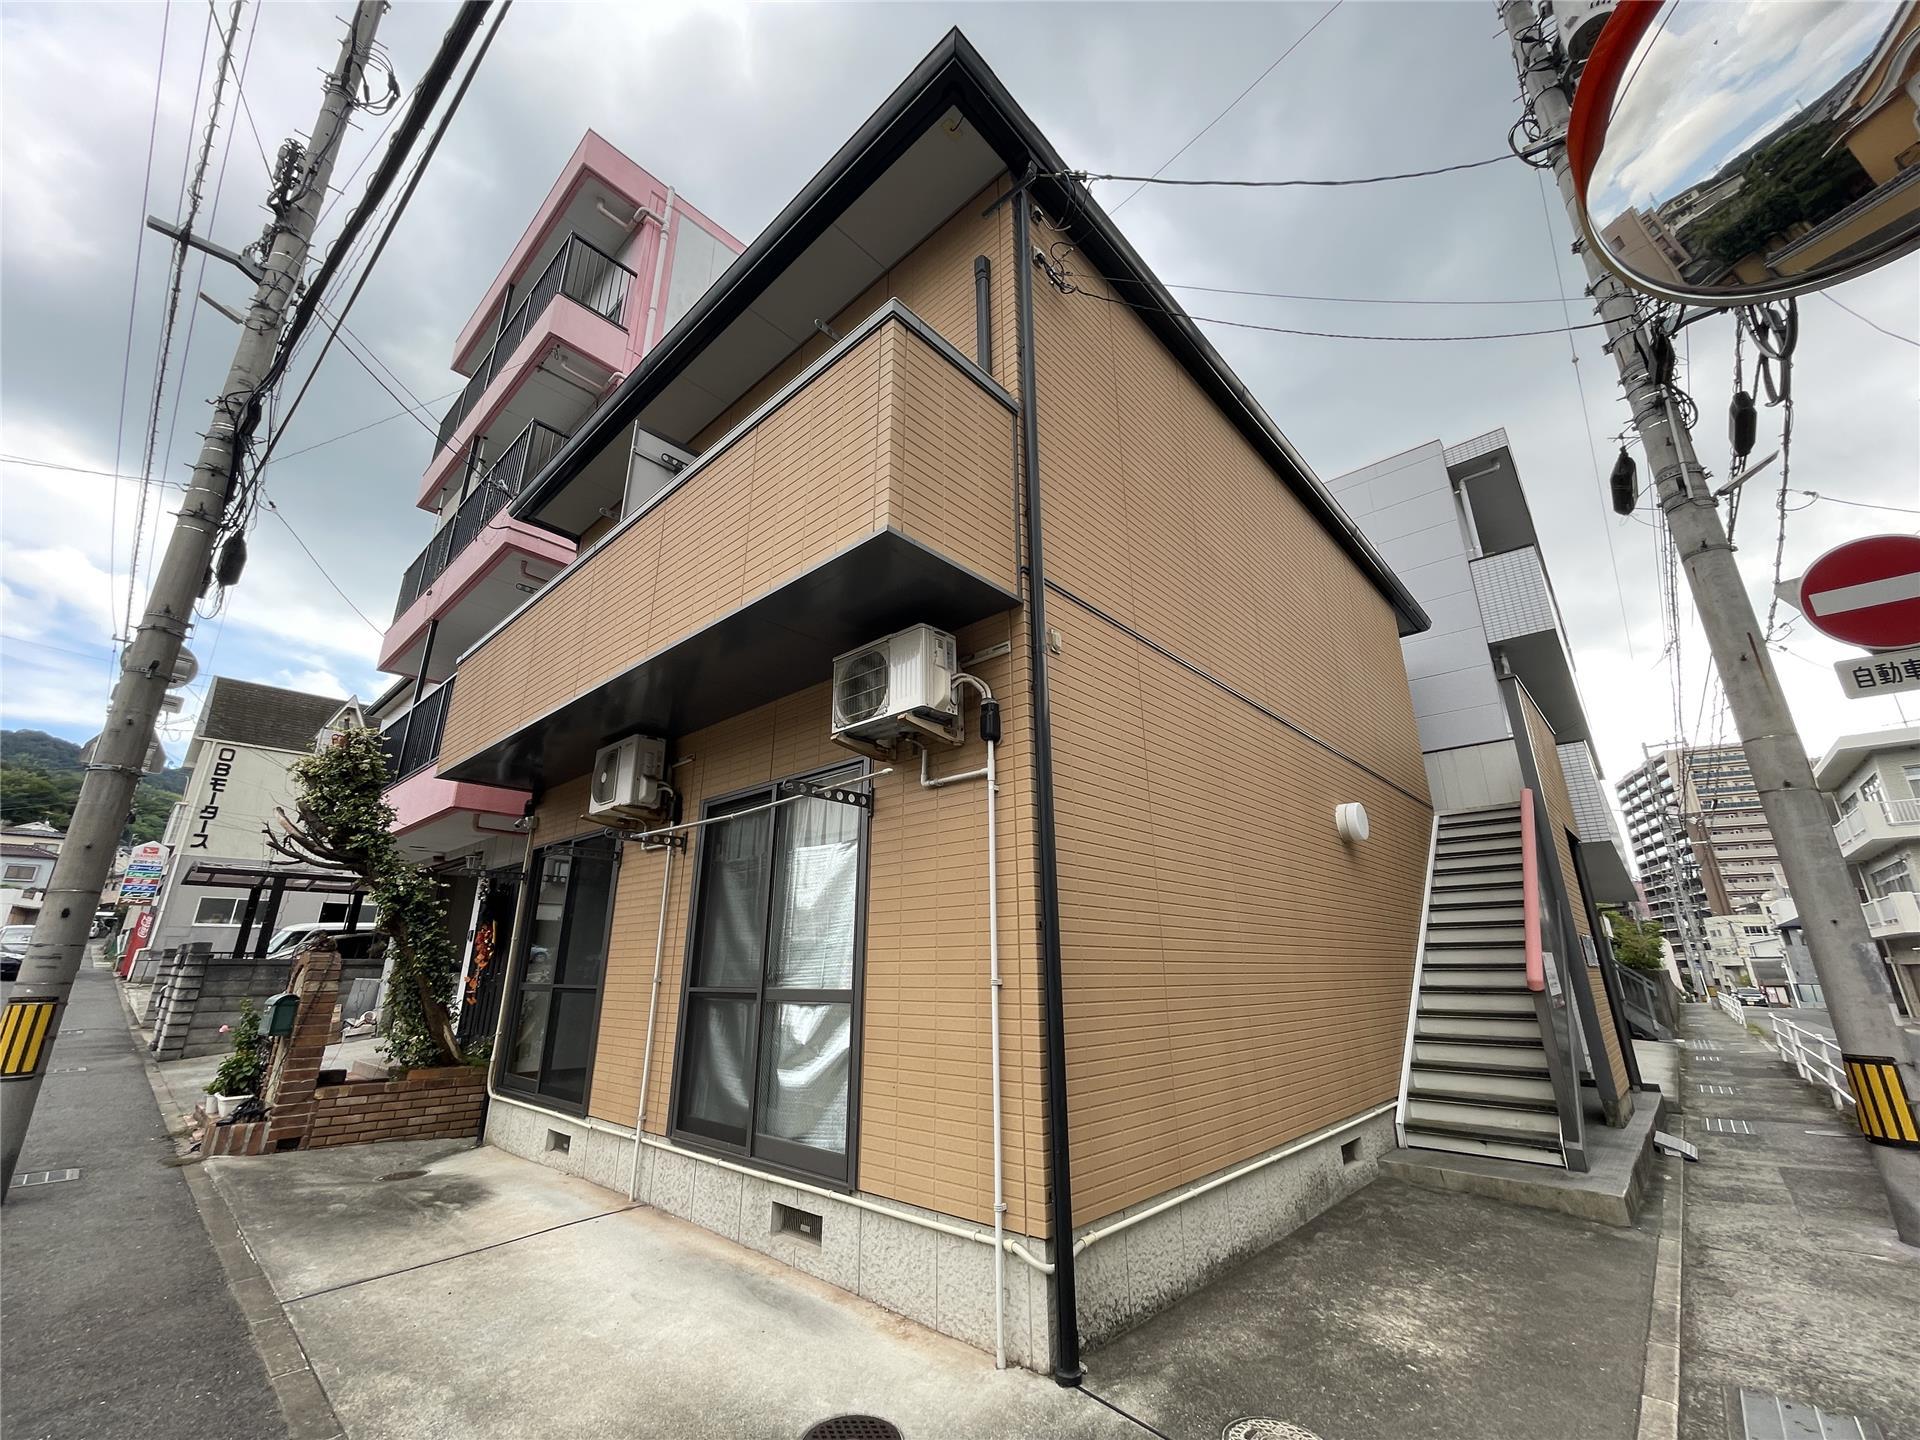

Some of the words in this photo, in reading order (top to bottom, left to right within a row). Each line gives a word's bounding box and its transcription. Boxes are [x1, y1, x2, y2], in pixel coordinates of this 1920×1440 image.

[1852, 659, 1920, 688] 自動車
[189, 747, 236, 849] OBモータース
